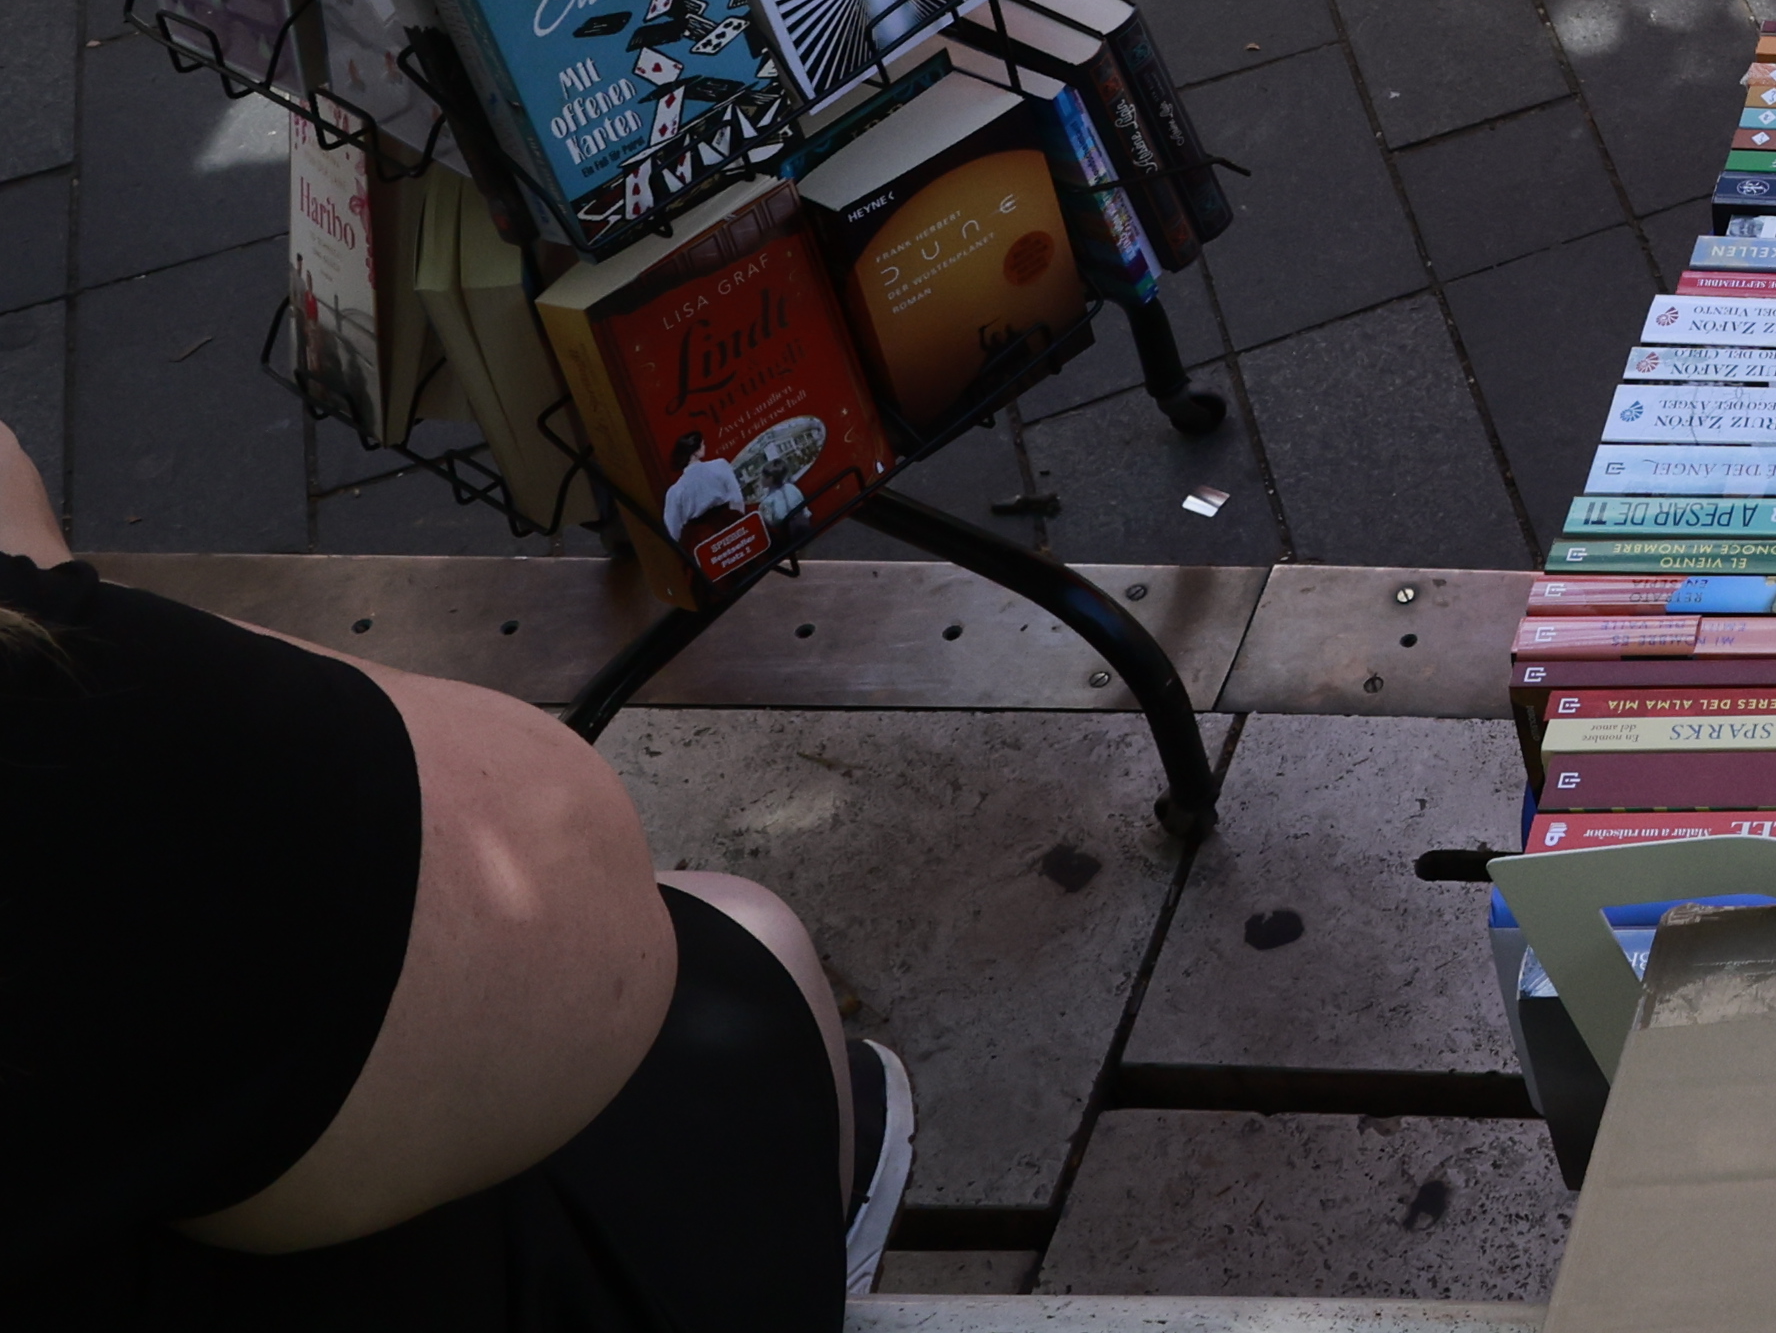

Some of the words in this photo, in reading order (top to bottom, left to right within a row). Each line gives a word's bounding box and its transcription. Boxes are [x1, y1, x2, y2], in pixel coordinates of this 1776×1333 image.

[558, 57, 603, 100] Mit
[550, 78, 638, 139] offenen
[565, 109, 644, 165] Karten
[298, 181, 356, 253] Haribo
[847, 196, 888, 223] HEYNE
[663, 295, 709, 331] LISA
[717, 253, 770, 295] GRAF
[1607, 700, 1640, 714] MÍA
[1644, 699, 1693, 711] ALMA
[1698, 699, 1732, 710] DEL
[1669, 723, 1774, 740] SPARKS
